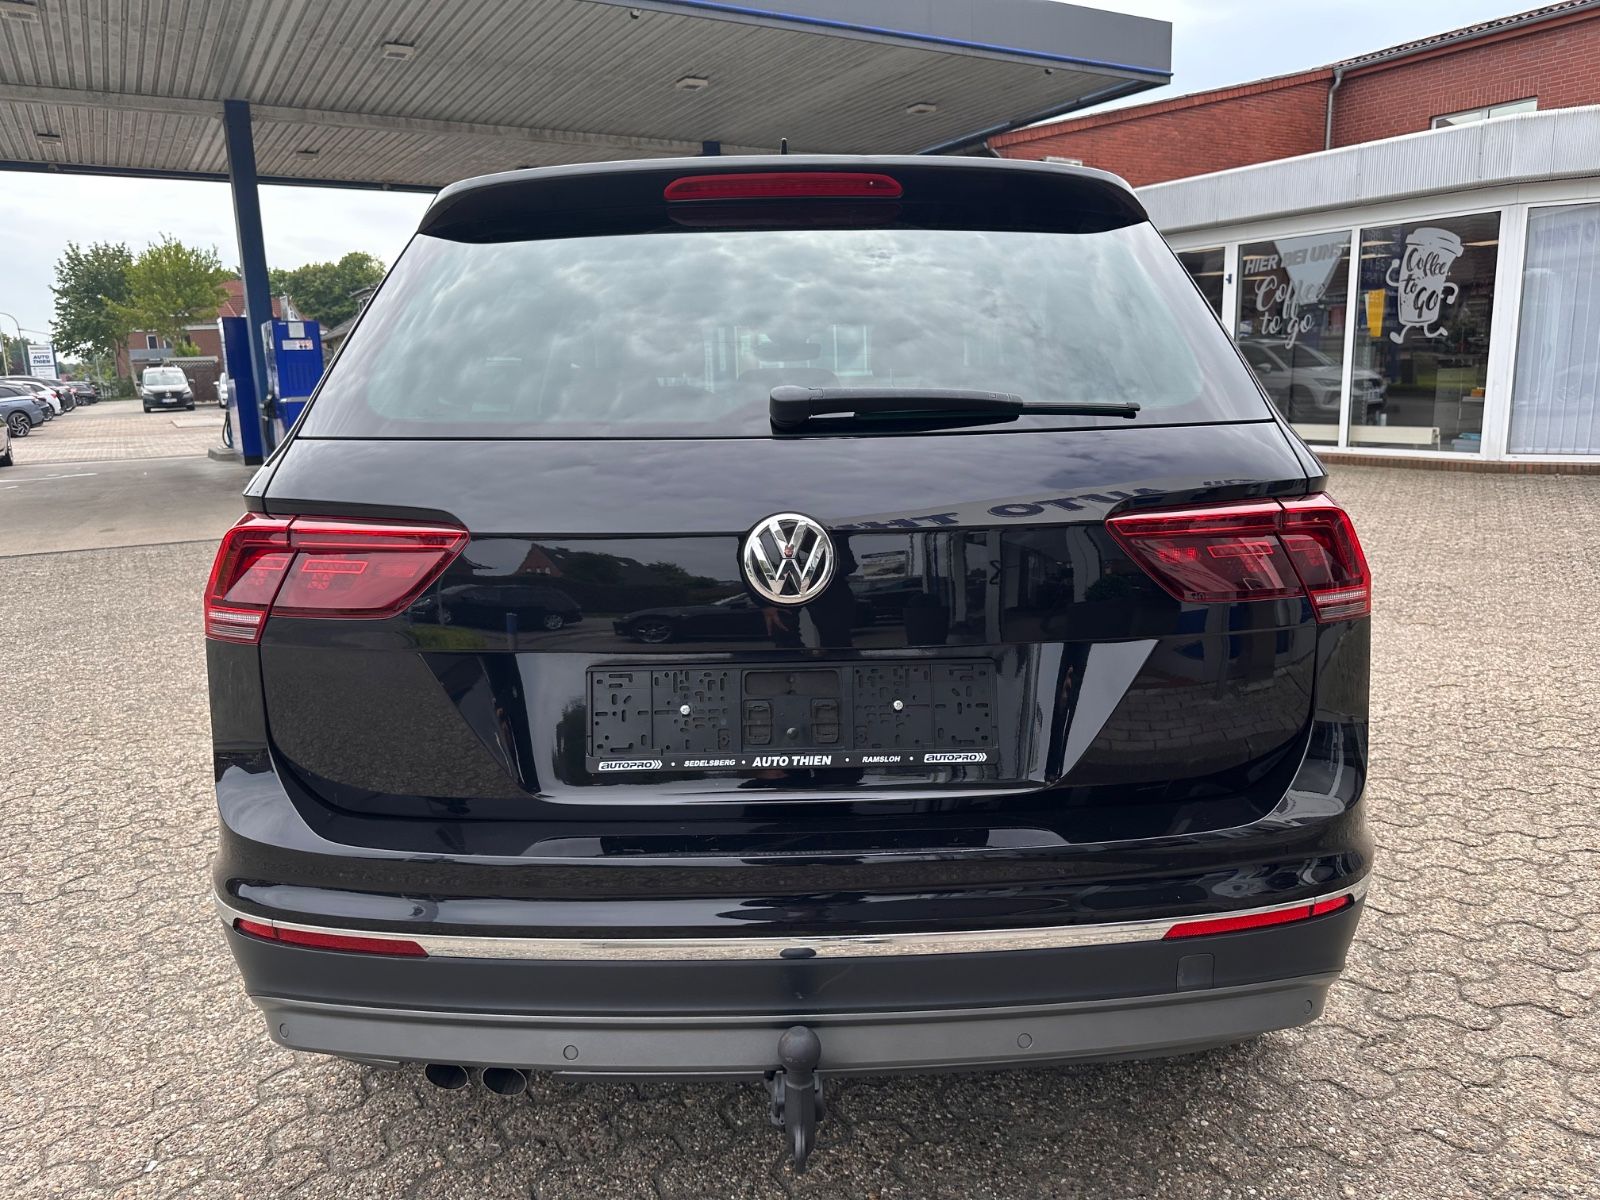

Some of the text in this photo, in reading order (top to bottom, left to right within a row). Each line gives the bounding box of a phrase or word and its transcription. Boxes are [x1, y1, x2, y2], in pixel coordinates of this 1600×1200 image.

[1244, 254, 1279, 275] HIER
[1406, 247, 1447, 277] Coffee
[1400, 274, 1418, 295] to
[1259, 311, 1316, 349] to go
[683, 759, 736, 767] SEDELSBERG
[752, 756, 788, 767] AUTO
[791, 755, 832, 766] THIEN
[862, 755, 901, 763] RAMSLOH
